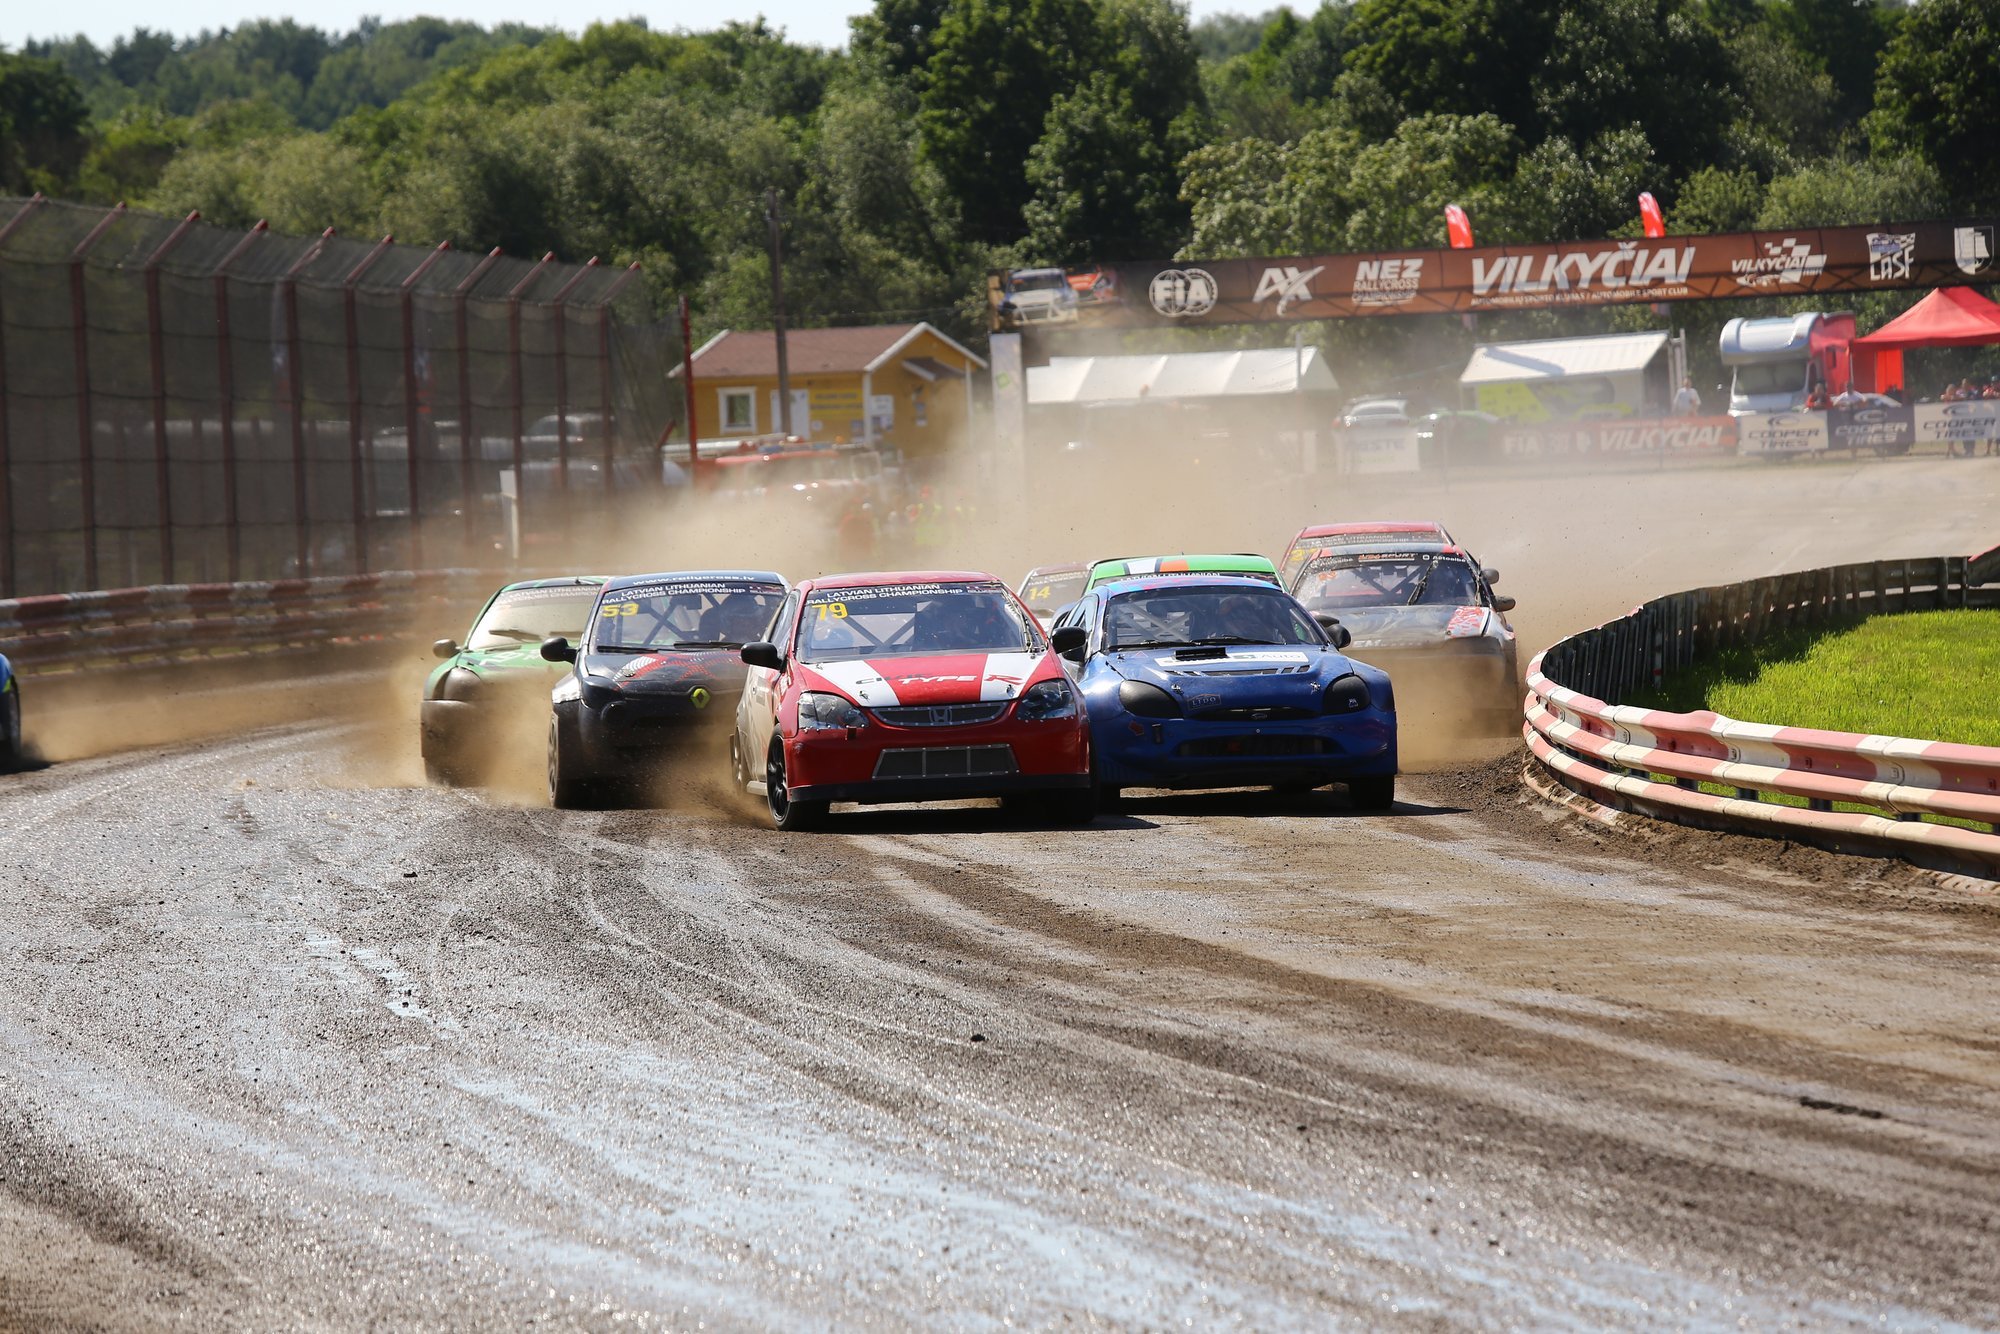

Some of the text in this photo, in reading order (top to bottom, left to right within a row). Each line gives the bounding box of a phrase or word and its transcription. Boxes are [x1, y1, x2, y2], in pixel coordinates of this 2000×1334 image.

[1355, 259, 1424, 280] NEZ
[1472, 241, 1697, 296] VILKYČIAI
[1731, 253, 1807, 274] VILKYČIAI
[1353, 279, 1420, 291] RALLYCROSS
[1591, 289, 1641, 300] AUTOMOBILE
[1642, 288, 1667, 298] SPORT
[1668, 286, 1689, 296] CLUB
[1834, 422, 1908, 437] COOPER
[1923, 417, 1996, 430] COOPER
[1600, 423, 1723, 450] VILKYČIAI
[1748, 428, 1819, 439] COOPER
[1846, 433, 1898, 446] TIRES
[1934, 429, 1985, 441] TIRES
[1760, 438, 1809, 449] TIRES
[601, 590, 667, 605] RALLYCROSS
[667, 588, 746, 597] CHAMPIONSHIP
[621, 583, 726, 597] LATVIAN LITHUANIAN
[806, 593, 878, 605] RALLYCROSS
[879, 588, 963, 598] CHAMPIONSHIP
[827, 584, 941, 598] LATVIAN LITHUANIAN
[1029, 586, 1051, 600] 14
[601, 603, 640, 618] 53
[812, 602, 848, 621] 79
[898, 674, 978, 685] TYPE
[984, 674, 1025, 686] R
